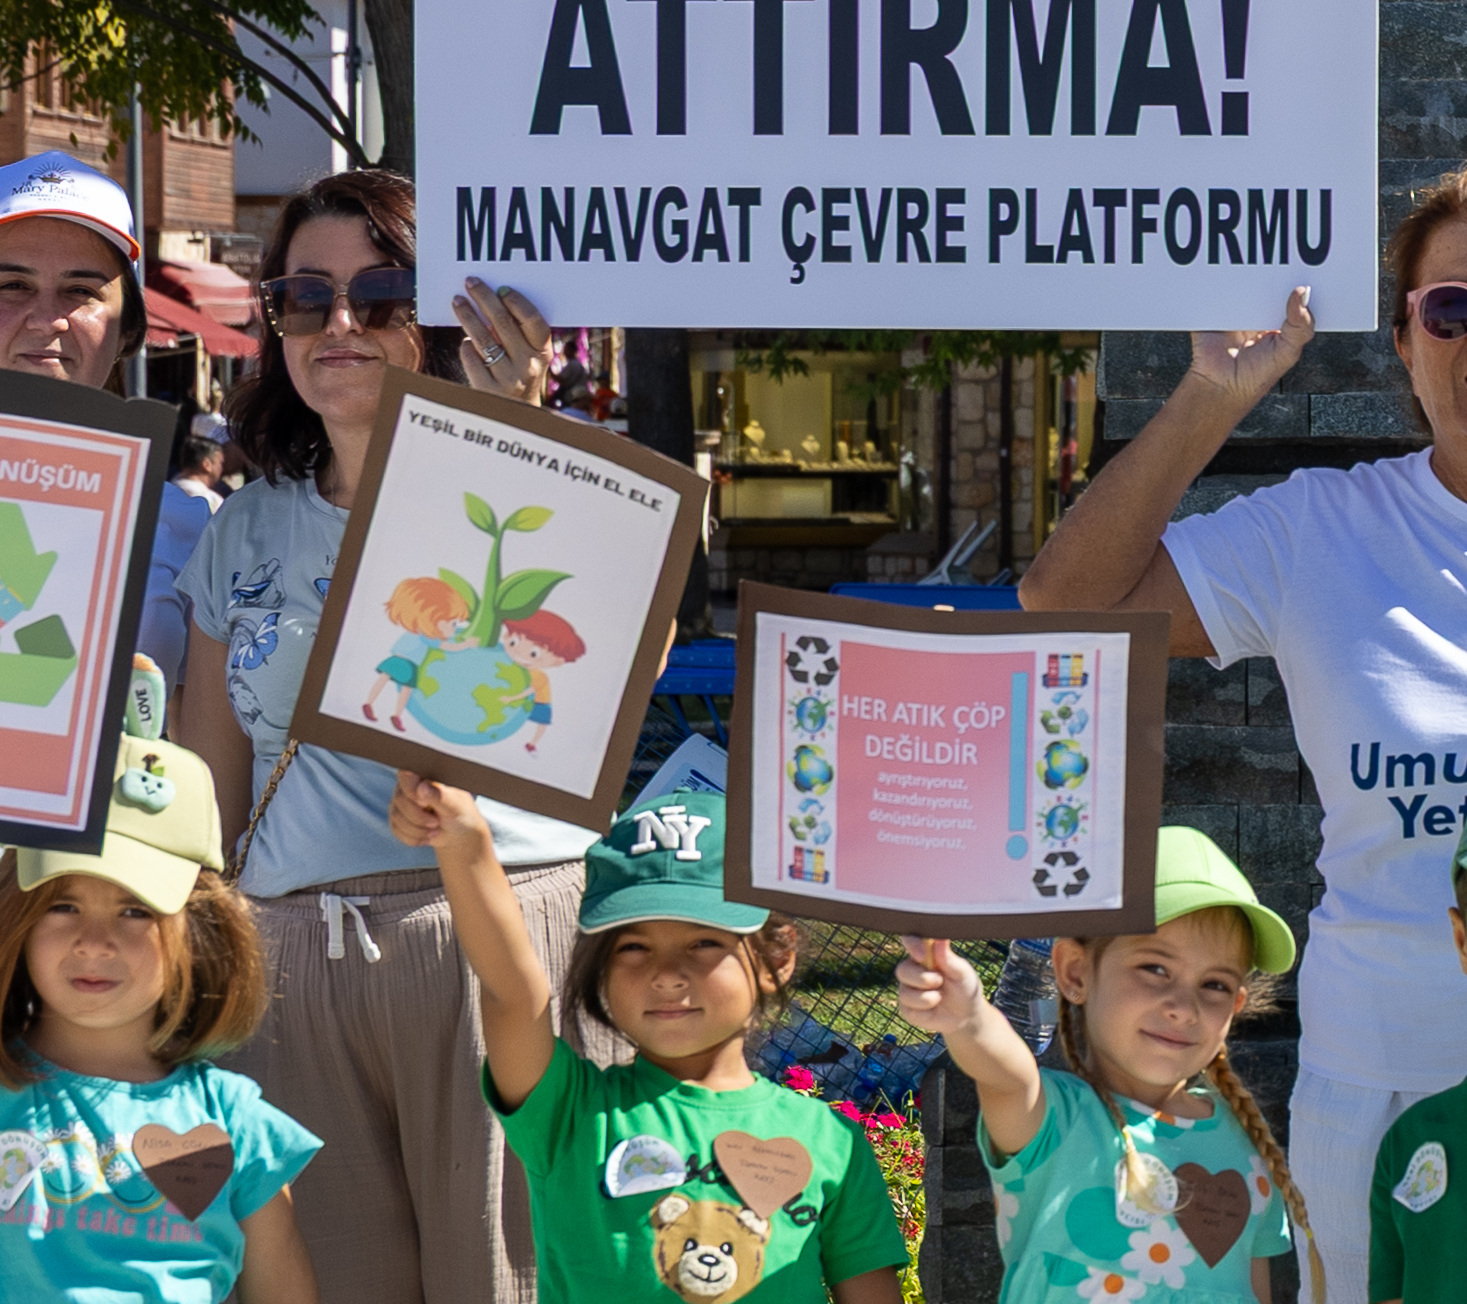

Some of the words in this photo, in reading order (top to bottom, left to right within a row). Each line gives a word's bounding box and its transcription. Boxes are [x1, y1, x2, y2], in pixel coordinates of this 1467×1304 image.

[456, 186, 762, 264] MANAVGAT
[782, 186, 967, 285] ÇEVRE
[989, 187, 1332, 266] PLATFORMU
[407, 409, 460, 438] YEŞİL
[462, 427, 493, 448] BİR
[496, 438, 560, 473] DÜNYA
[563, 459, 600, 487] İÇİN
[604, 476, 626, 496] EL
[629, 488, 663, 512] ELE
[135, 687, 153, 723] LOVE
[841, 694, 888, 722] HER
[892, 702, 947, 729] ATIK
[953, 701, 1006, 734] ÇÖP
[865, 733, 979, 766] DEĞİLDİR
[631, 805, 712, 861] NY
[76, 1205, 137, 1237] take
